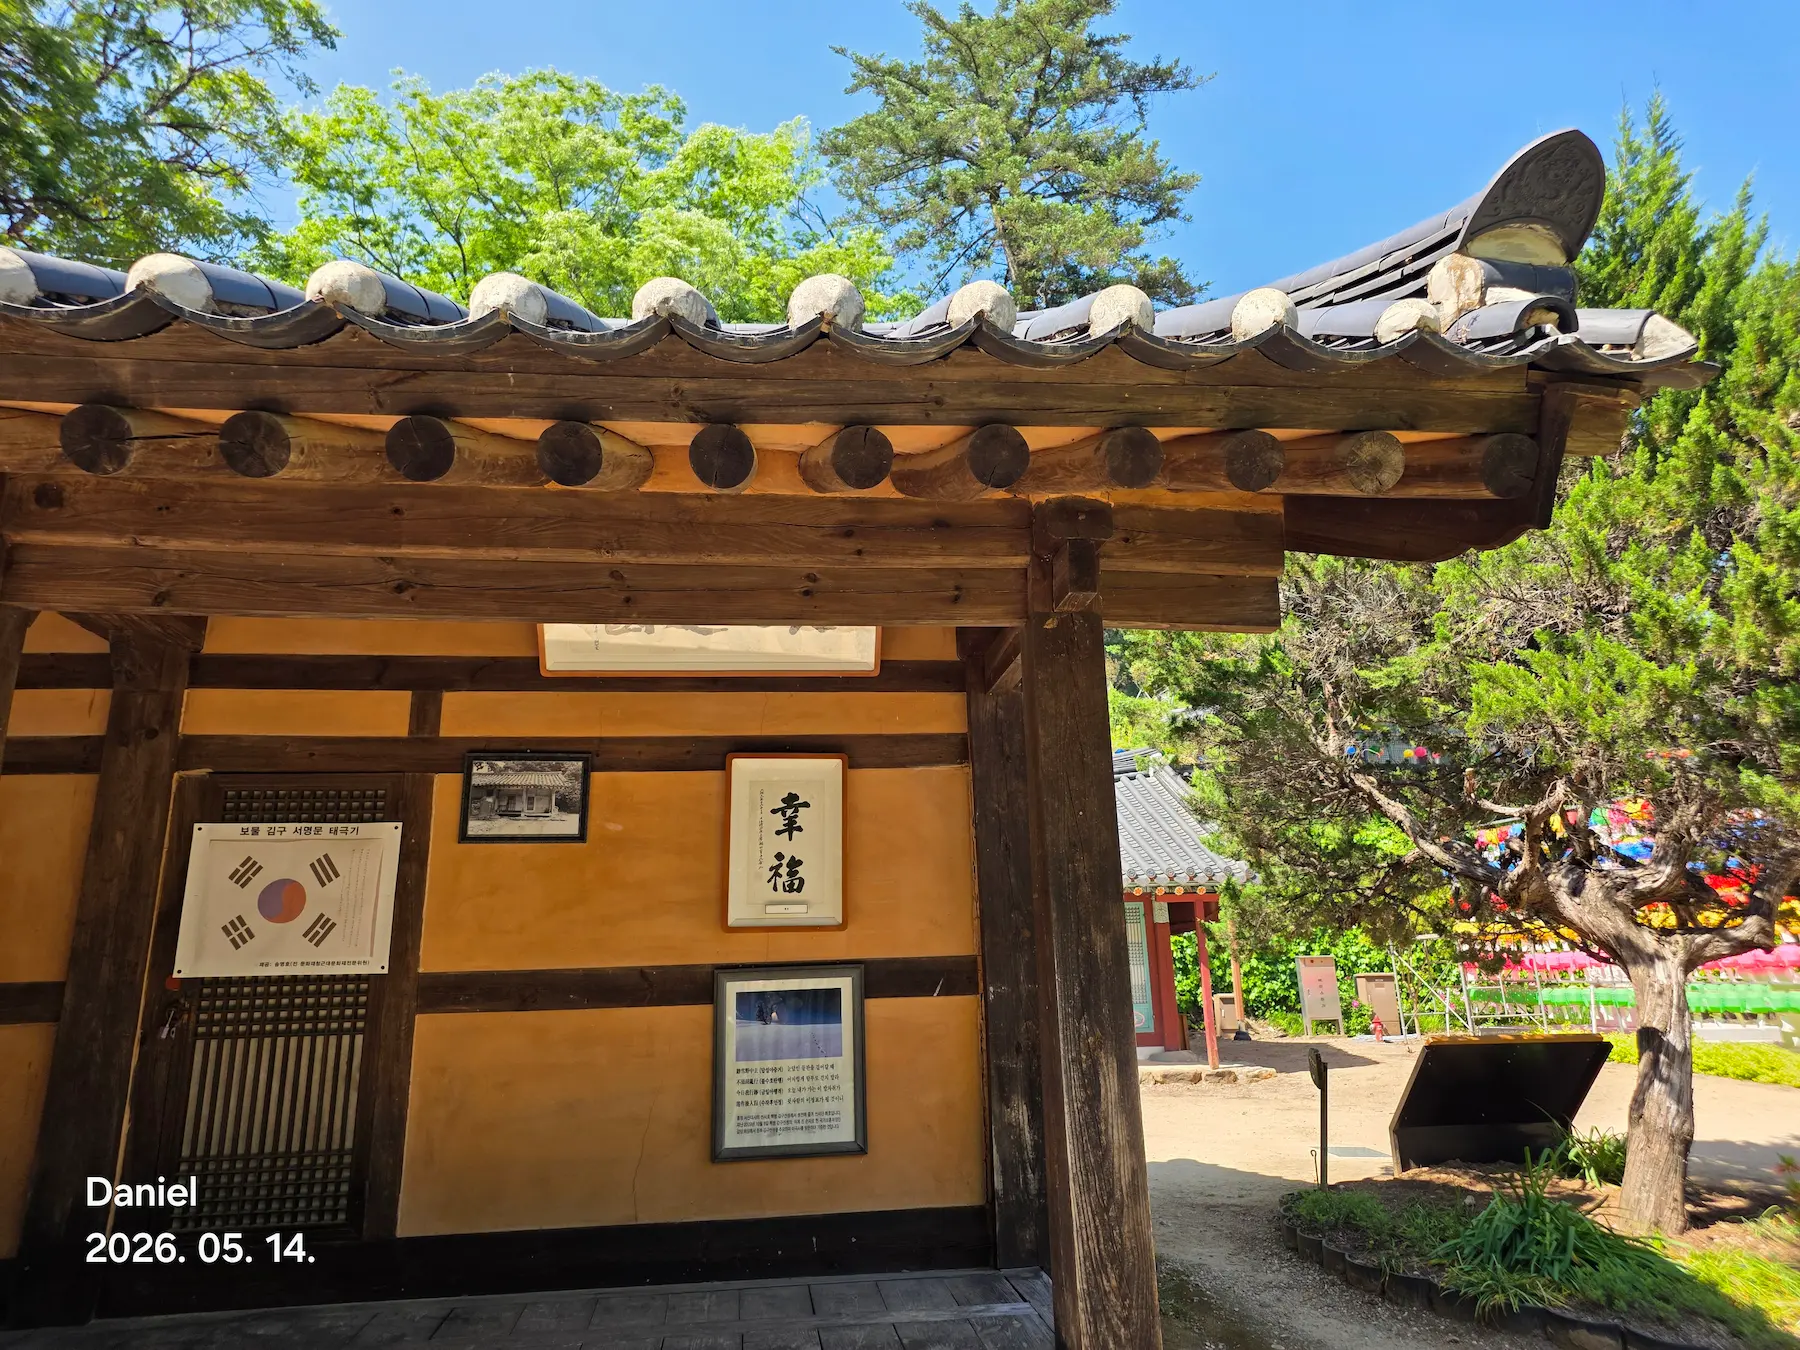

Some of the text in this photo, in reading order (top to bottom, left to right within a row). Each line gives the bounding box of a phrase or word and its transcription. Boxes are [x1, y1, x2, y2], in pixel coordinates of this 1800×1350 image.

[240, 825, 360, 836] 보물 김구 서명문 태극기
[767, 792, 811, 894] 幸福
